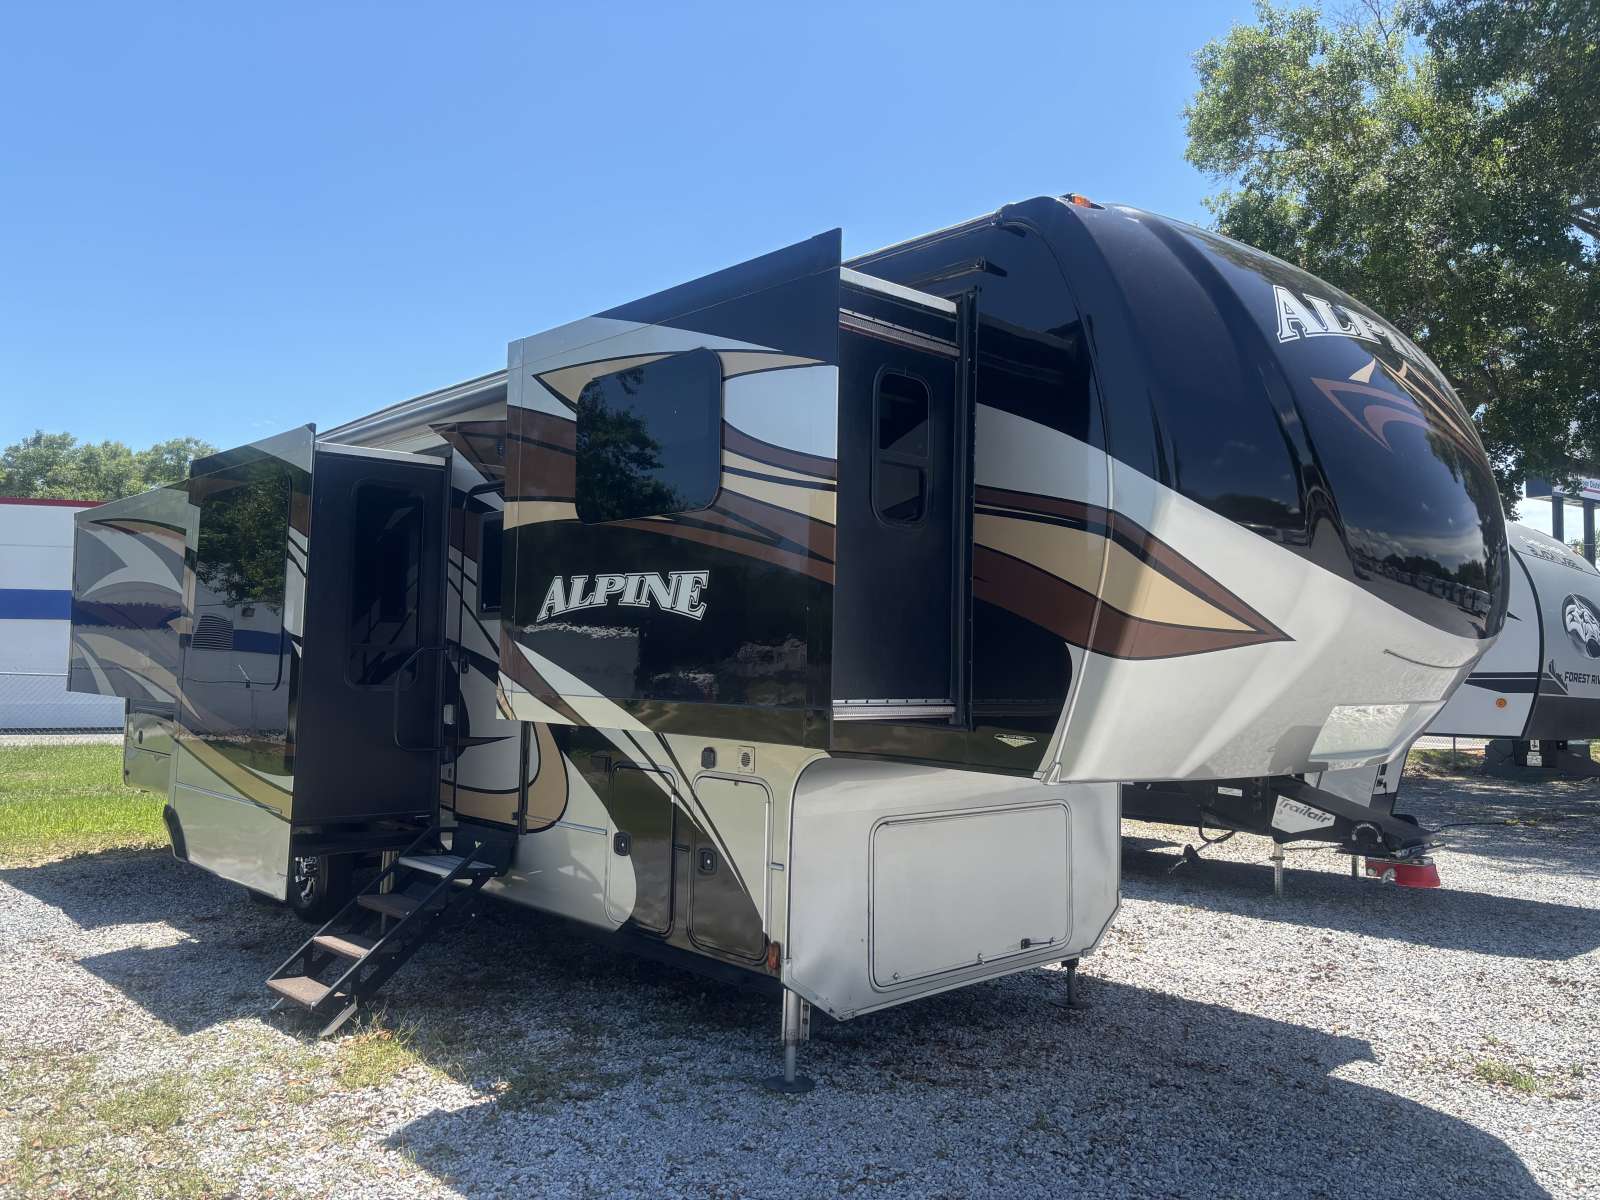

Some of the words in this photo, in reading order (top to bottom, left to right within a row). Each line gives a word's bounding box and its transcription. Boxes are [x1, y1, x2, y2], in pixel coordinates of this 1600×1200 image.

[536, 569, 710, 623] ALPINE
[1564, 671, 1591, 685] FOREST
[1278, 797, 1333, 823] Trailair
